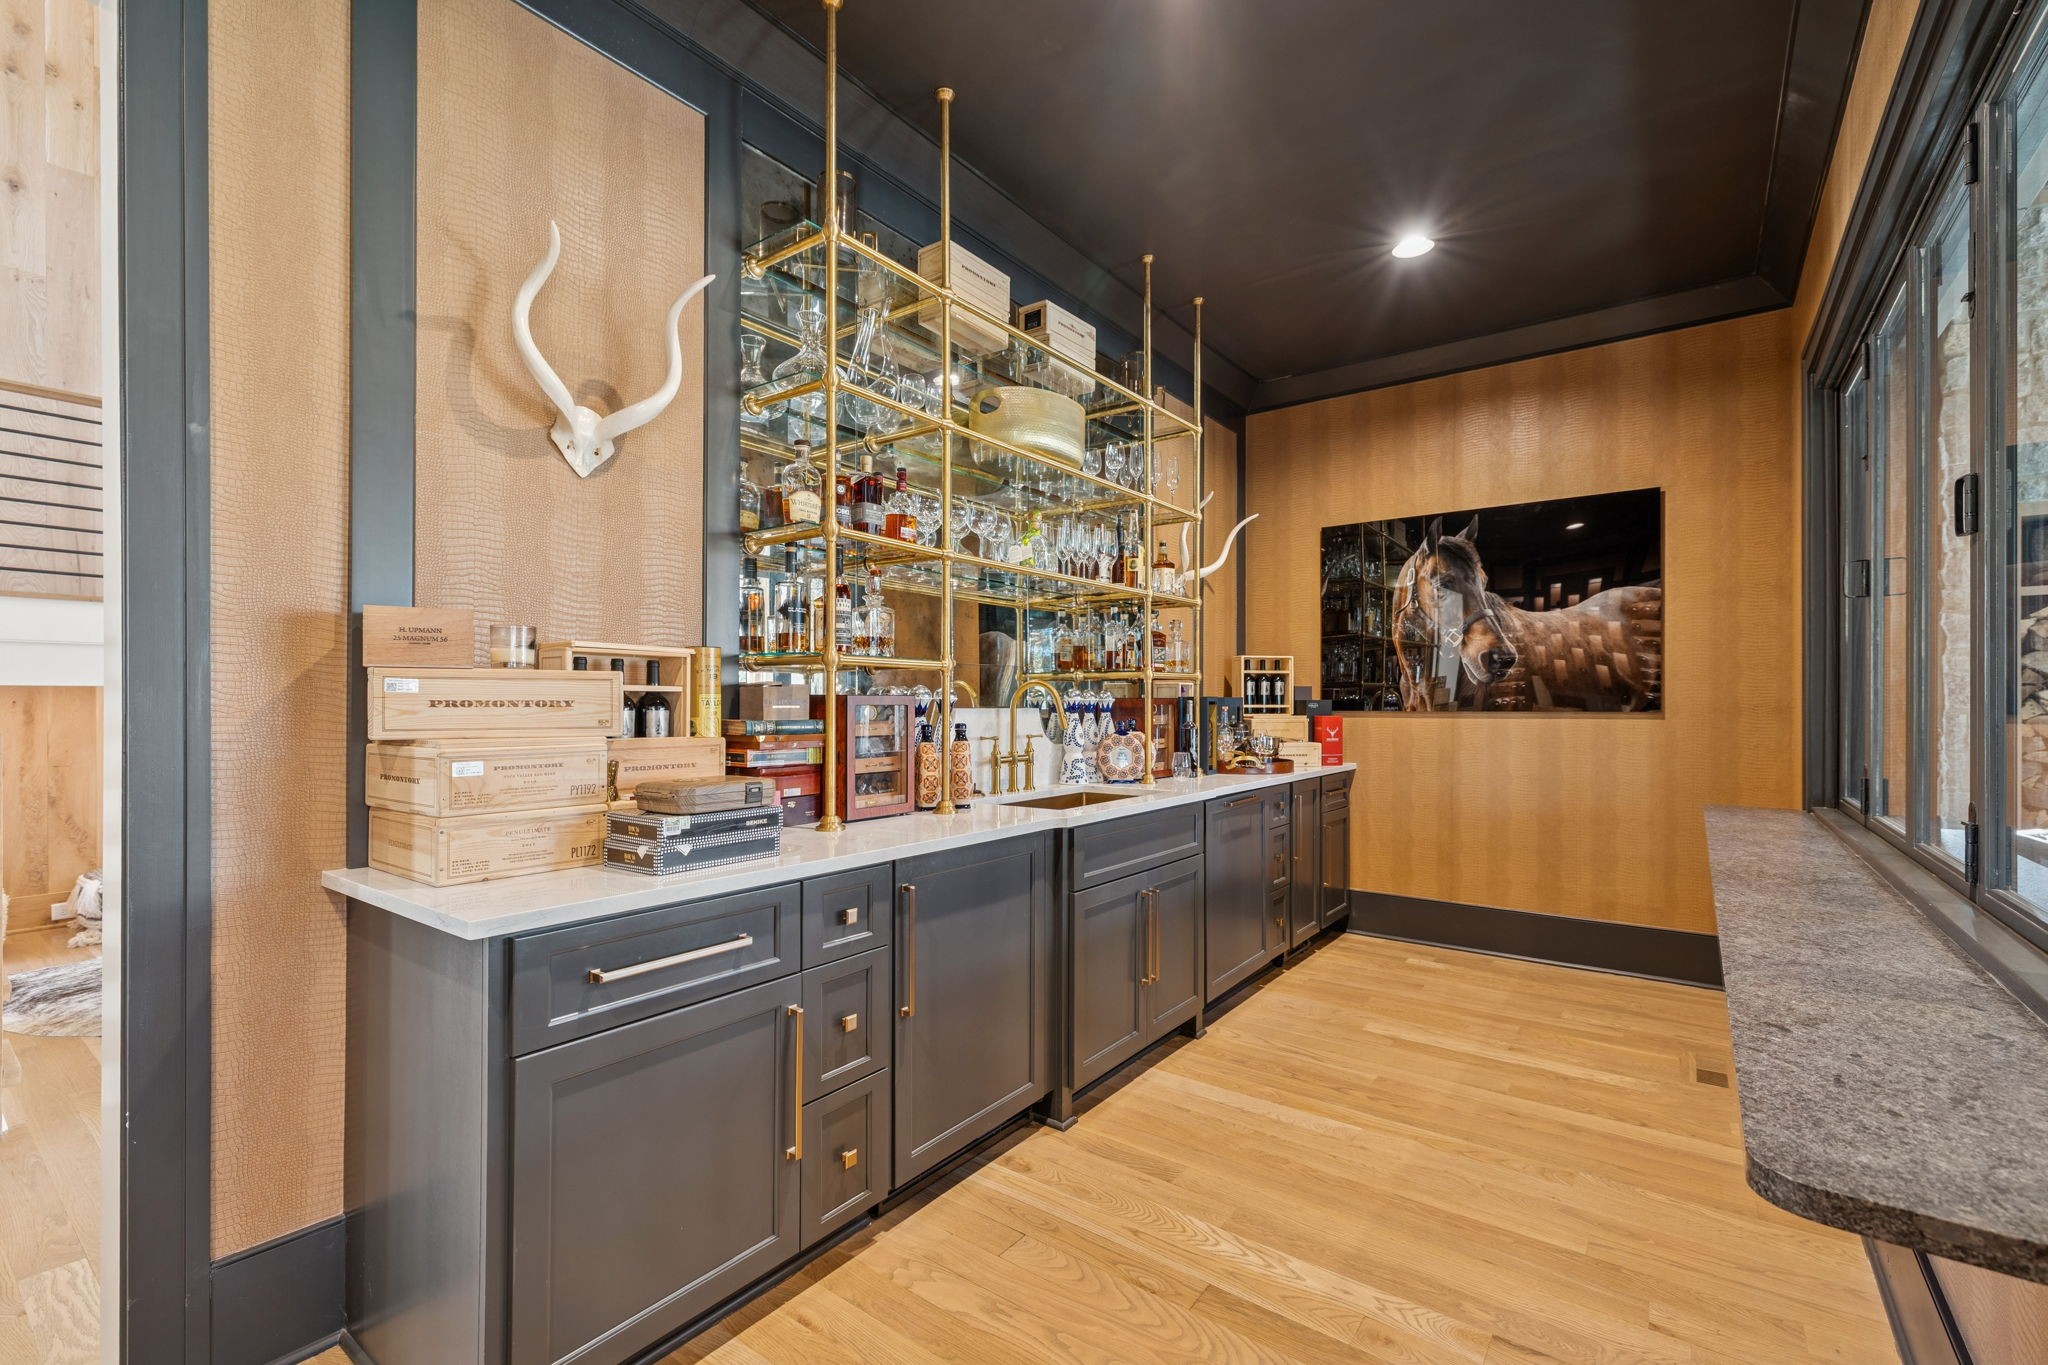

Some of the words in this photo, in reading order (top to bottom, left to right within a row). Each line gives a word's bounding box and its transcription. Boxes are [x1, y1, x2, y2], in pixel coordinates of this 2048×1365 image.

[428, 699, 576, 708] PROMONTORY
[493, 762, 565, 772] PROMONTORY
[623, 762, 697, 773] PROMONTORY
[380, 773, 421, 784] PROMONTORY
[570, 784, 597, 796] PY1192
[505, 826, 552, 837] PENULTIMATE
[571, 844, 597, 859] PL1172
